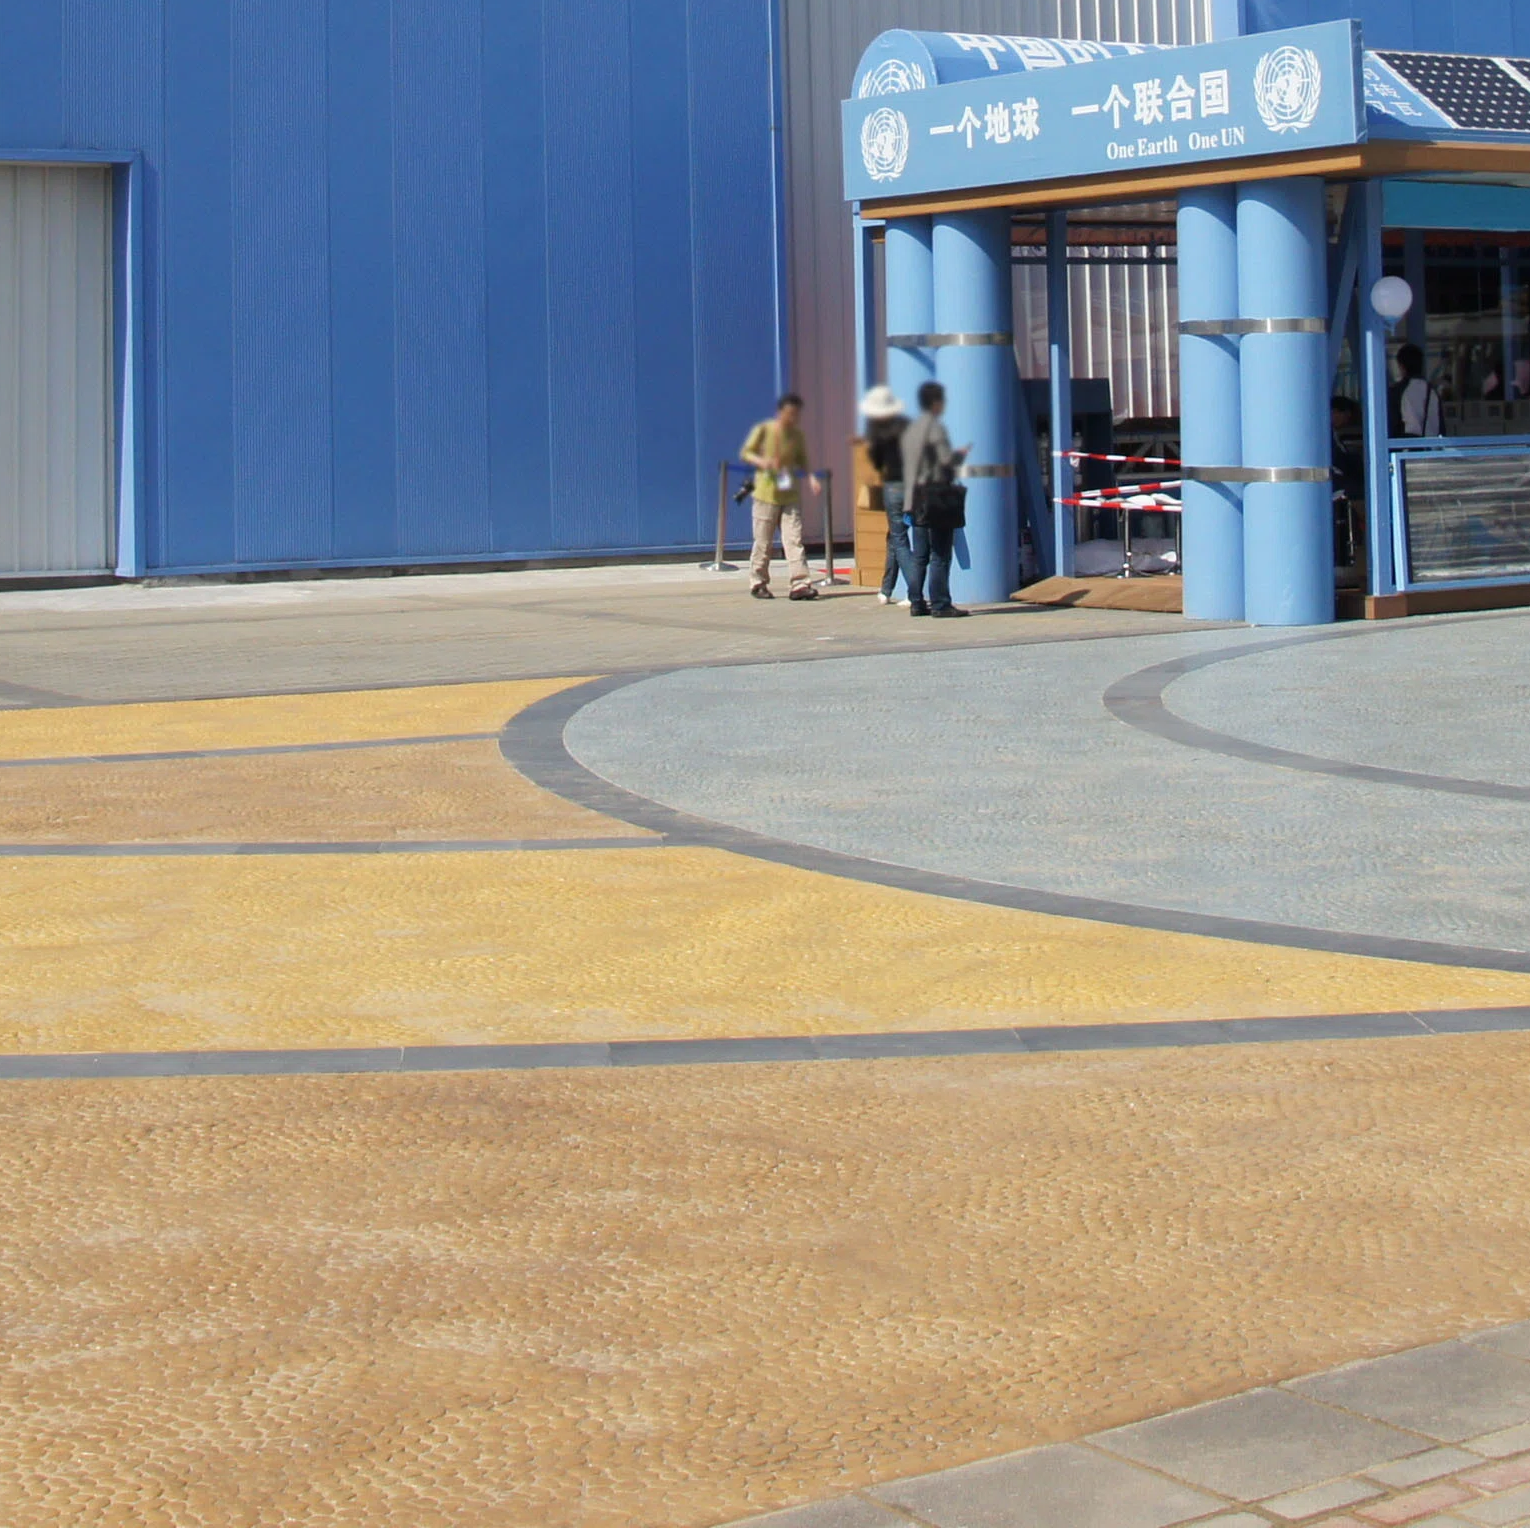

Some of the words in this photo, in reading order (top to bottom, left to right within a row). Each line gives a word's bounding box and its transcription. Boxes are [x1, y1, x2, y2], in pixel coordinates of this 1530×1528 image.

[930, 97, 1041, 149] 一个地球
[1071, 69, 1229, 129] 一个联合国
[1107, 142, 1135, 160] One
[1137, 136, 1178, 155] Earth
[1188, 132, 1218, 151] One
[1221, 126, 1245, 146] UN
